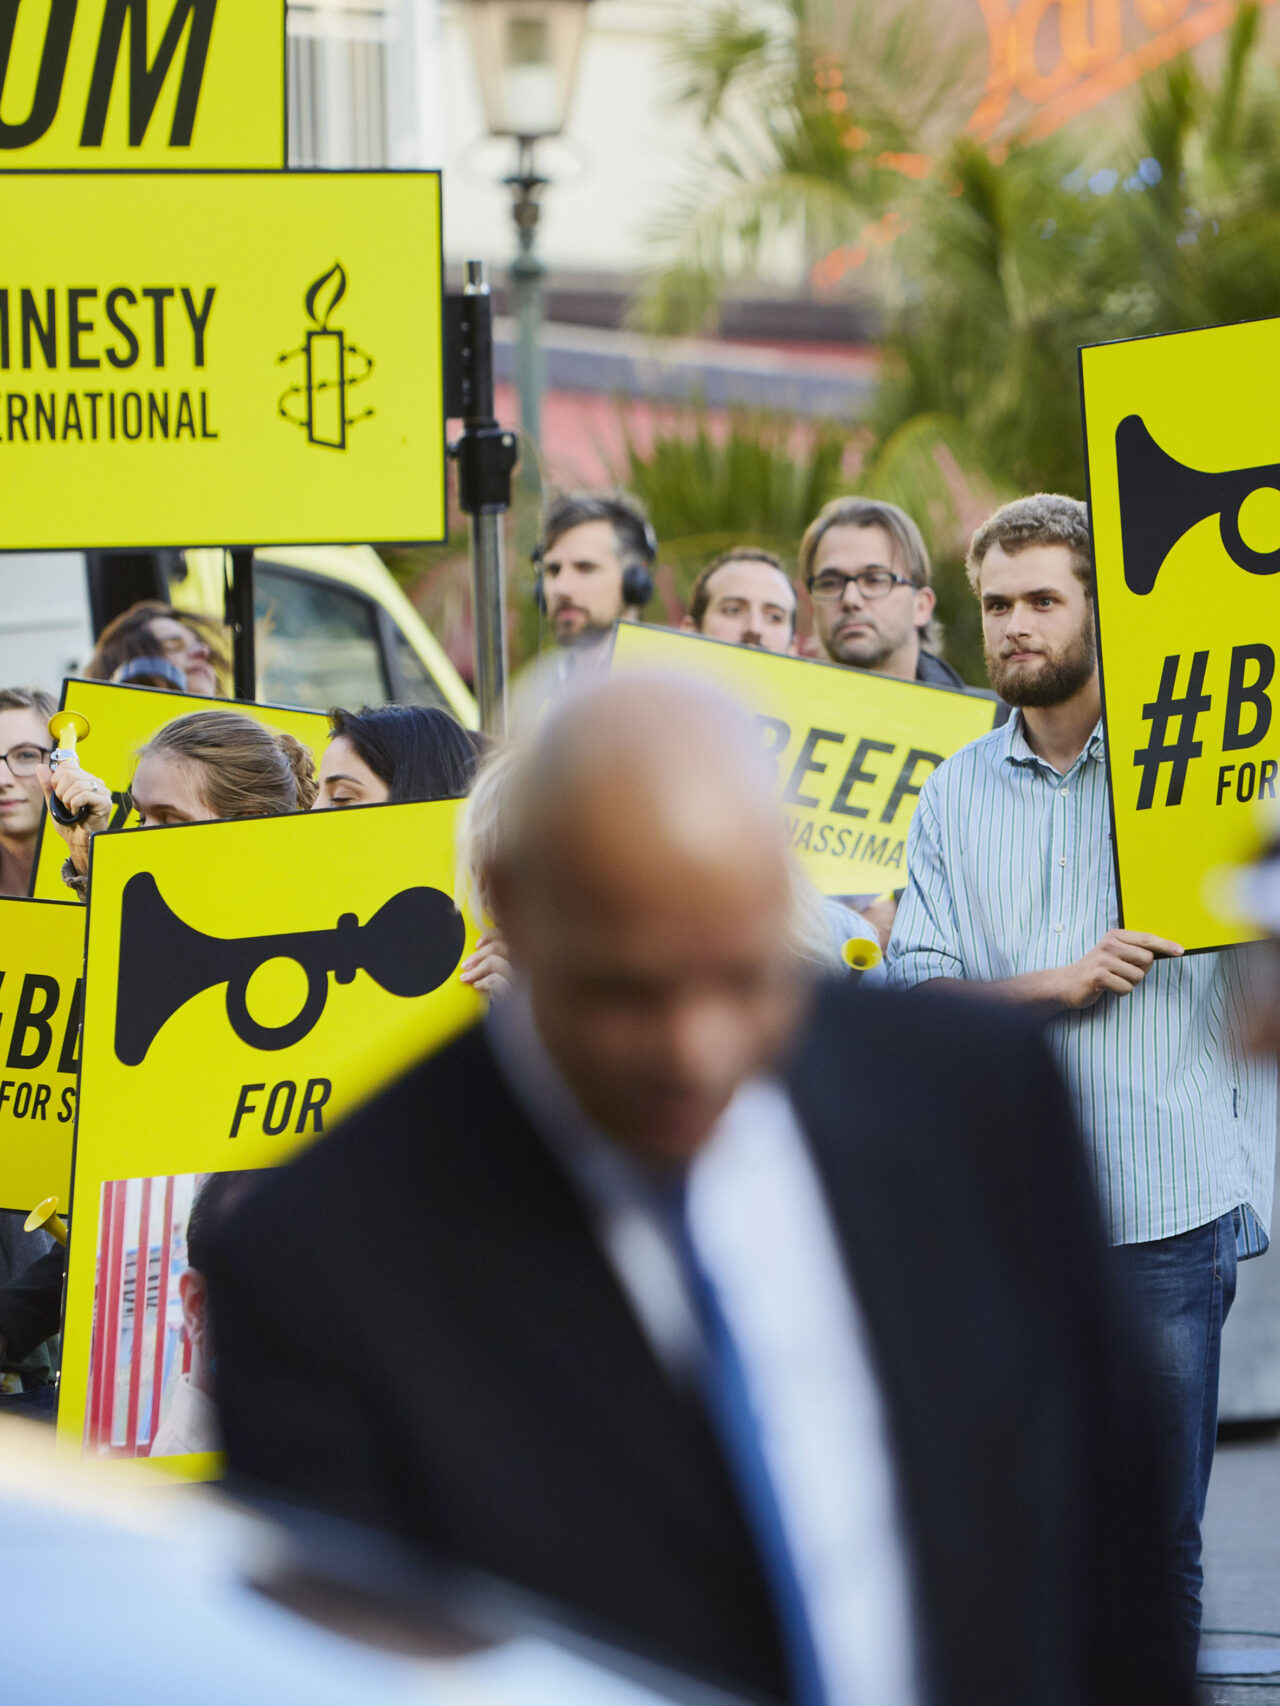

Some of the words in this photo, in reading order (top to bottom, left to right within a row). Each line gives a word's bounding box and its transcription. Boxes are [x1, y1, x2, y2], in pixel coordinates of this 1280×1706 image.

[0, 391, 218, 442] RNATIONAL
[1216, 759, 1278, 806] FOR
[229, 1078, 332, 1138] FOR
